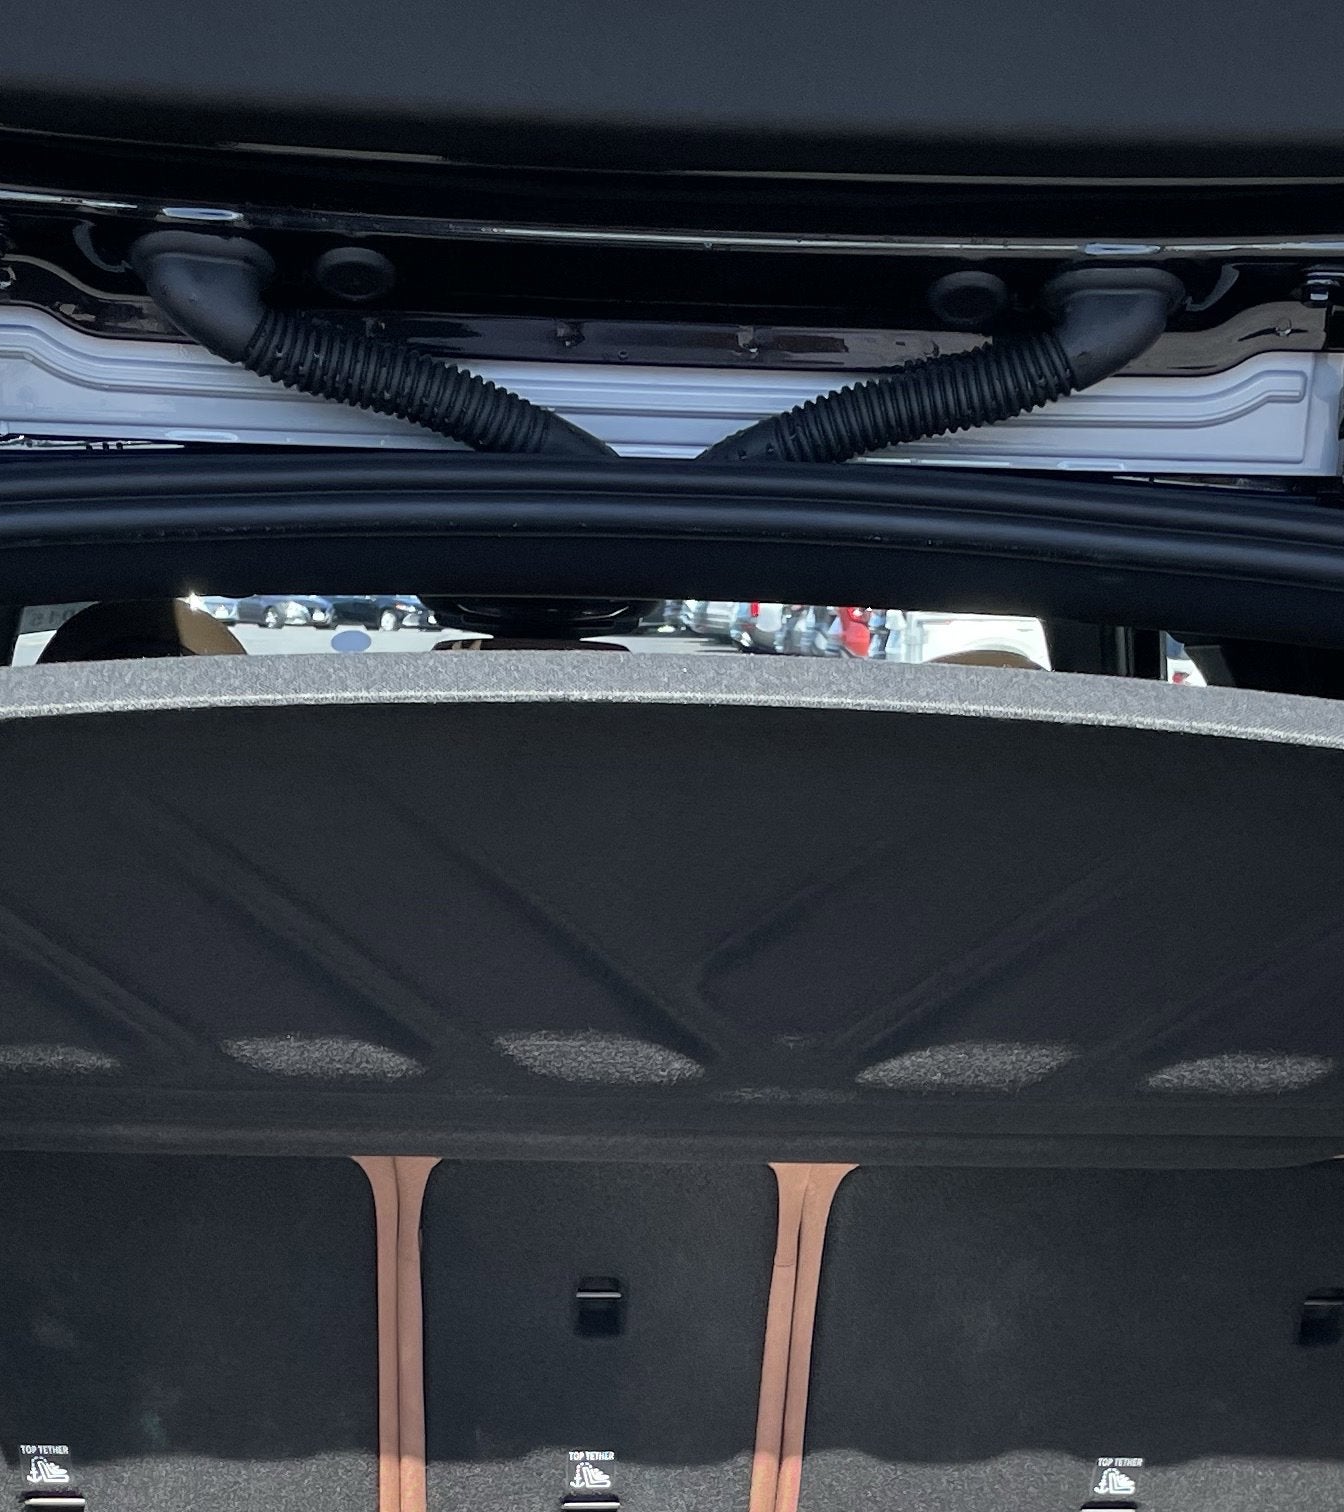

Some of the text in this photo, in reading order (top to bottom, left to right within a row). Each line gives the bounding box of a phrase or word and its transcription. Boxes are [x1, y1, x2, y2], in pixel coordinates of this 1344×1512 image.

[20, 1444, 69, 1455] TOP TETHER
[568, 1451, 615, 1461] TOP TETHER
[1098, 1457, 1143, 1467] TOP TETHER
